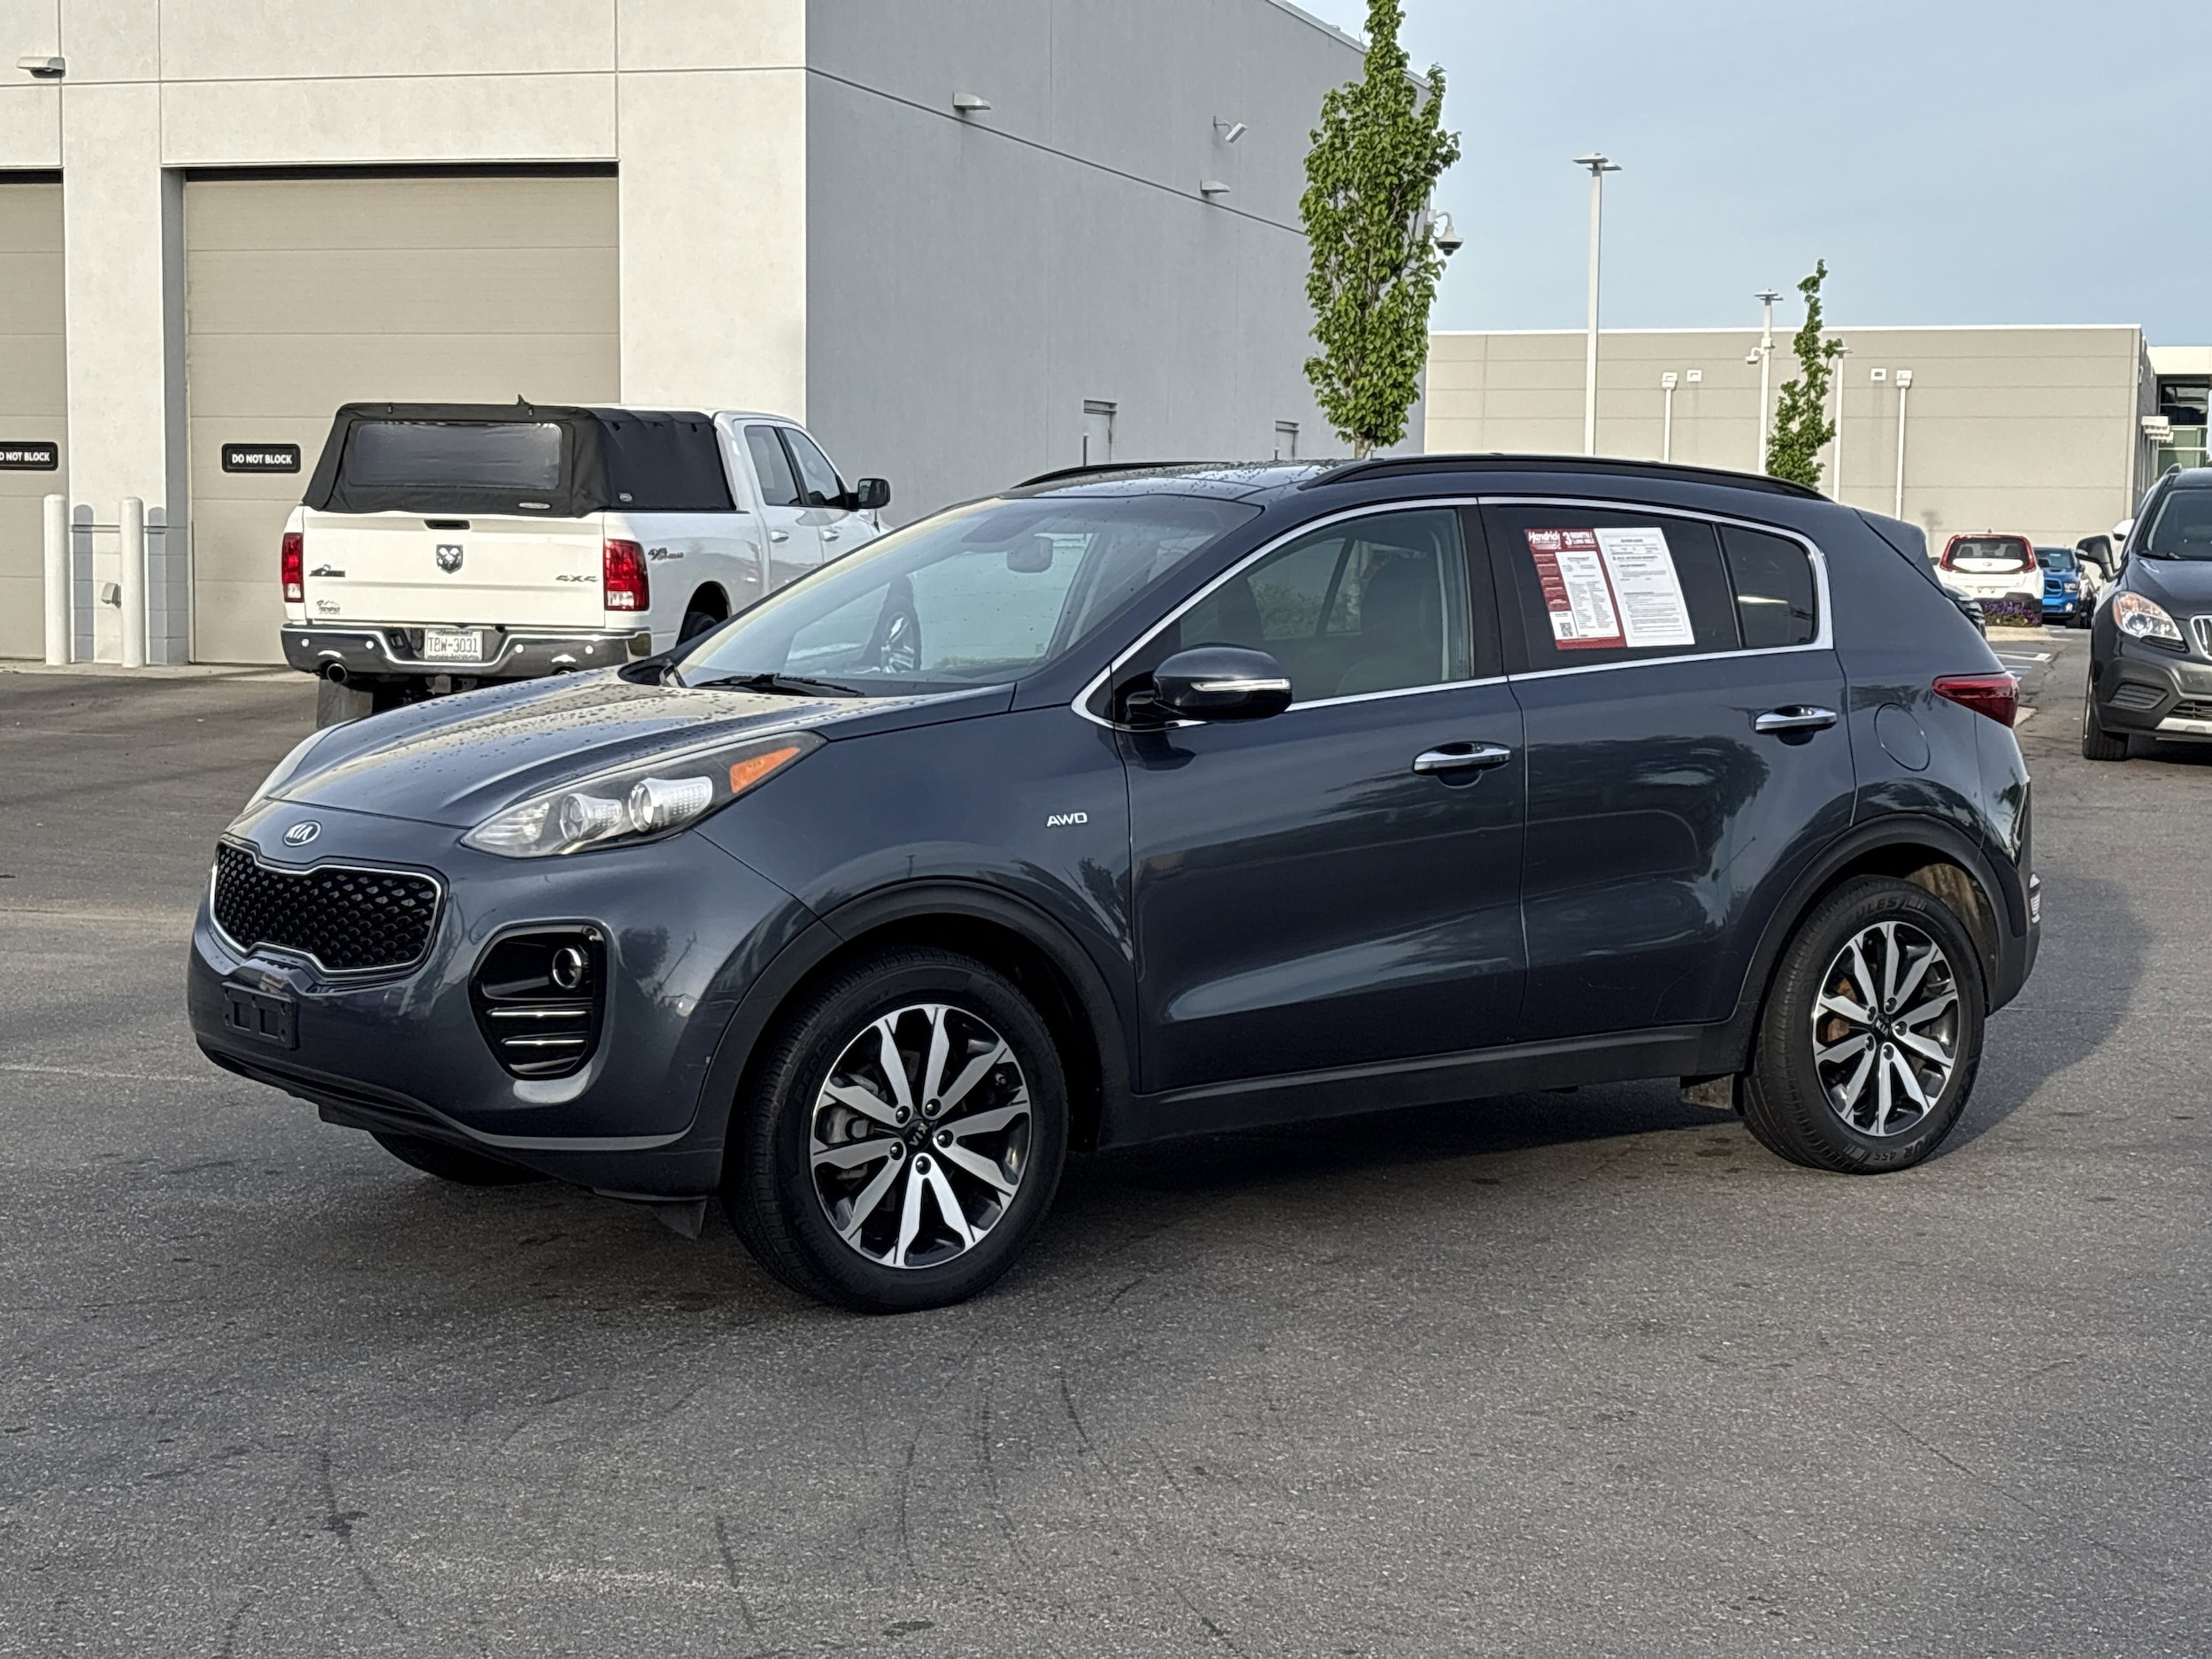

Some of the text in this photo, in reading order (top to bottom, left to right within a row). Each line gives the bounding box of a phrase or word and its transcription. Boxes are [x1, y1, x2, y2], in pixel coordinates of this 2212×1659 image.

[5, 451, 23, 462] NOT
[24, 451, 50, 462] BLOCK
[232, 453, 292, 465] DO NOT BLOCK
[1562, 531, 1572, 545] 3
[428, 636, 479, 653] TBW-3031
[1046, 811, 1088, 827] AWD
[286, 824, 314, 841] KIA
[1875, 1018, 1889, 1037] KIA
[908, 1122, 929, 1148] KIA
